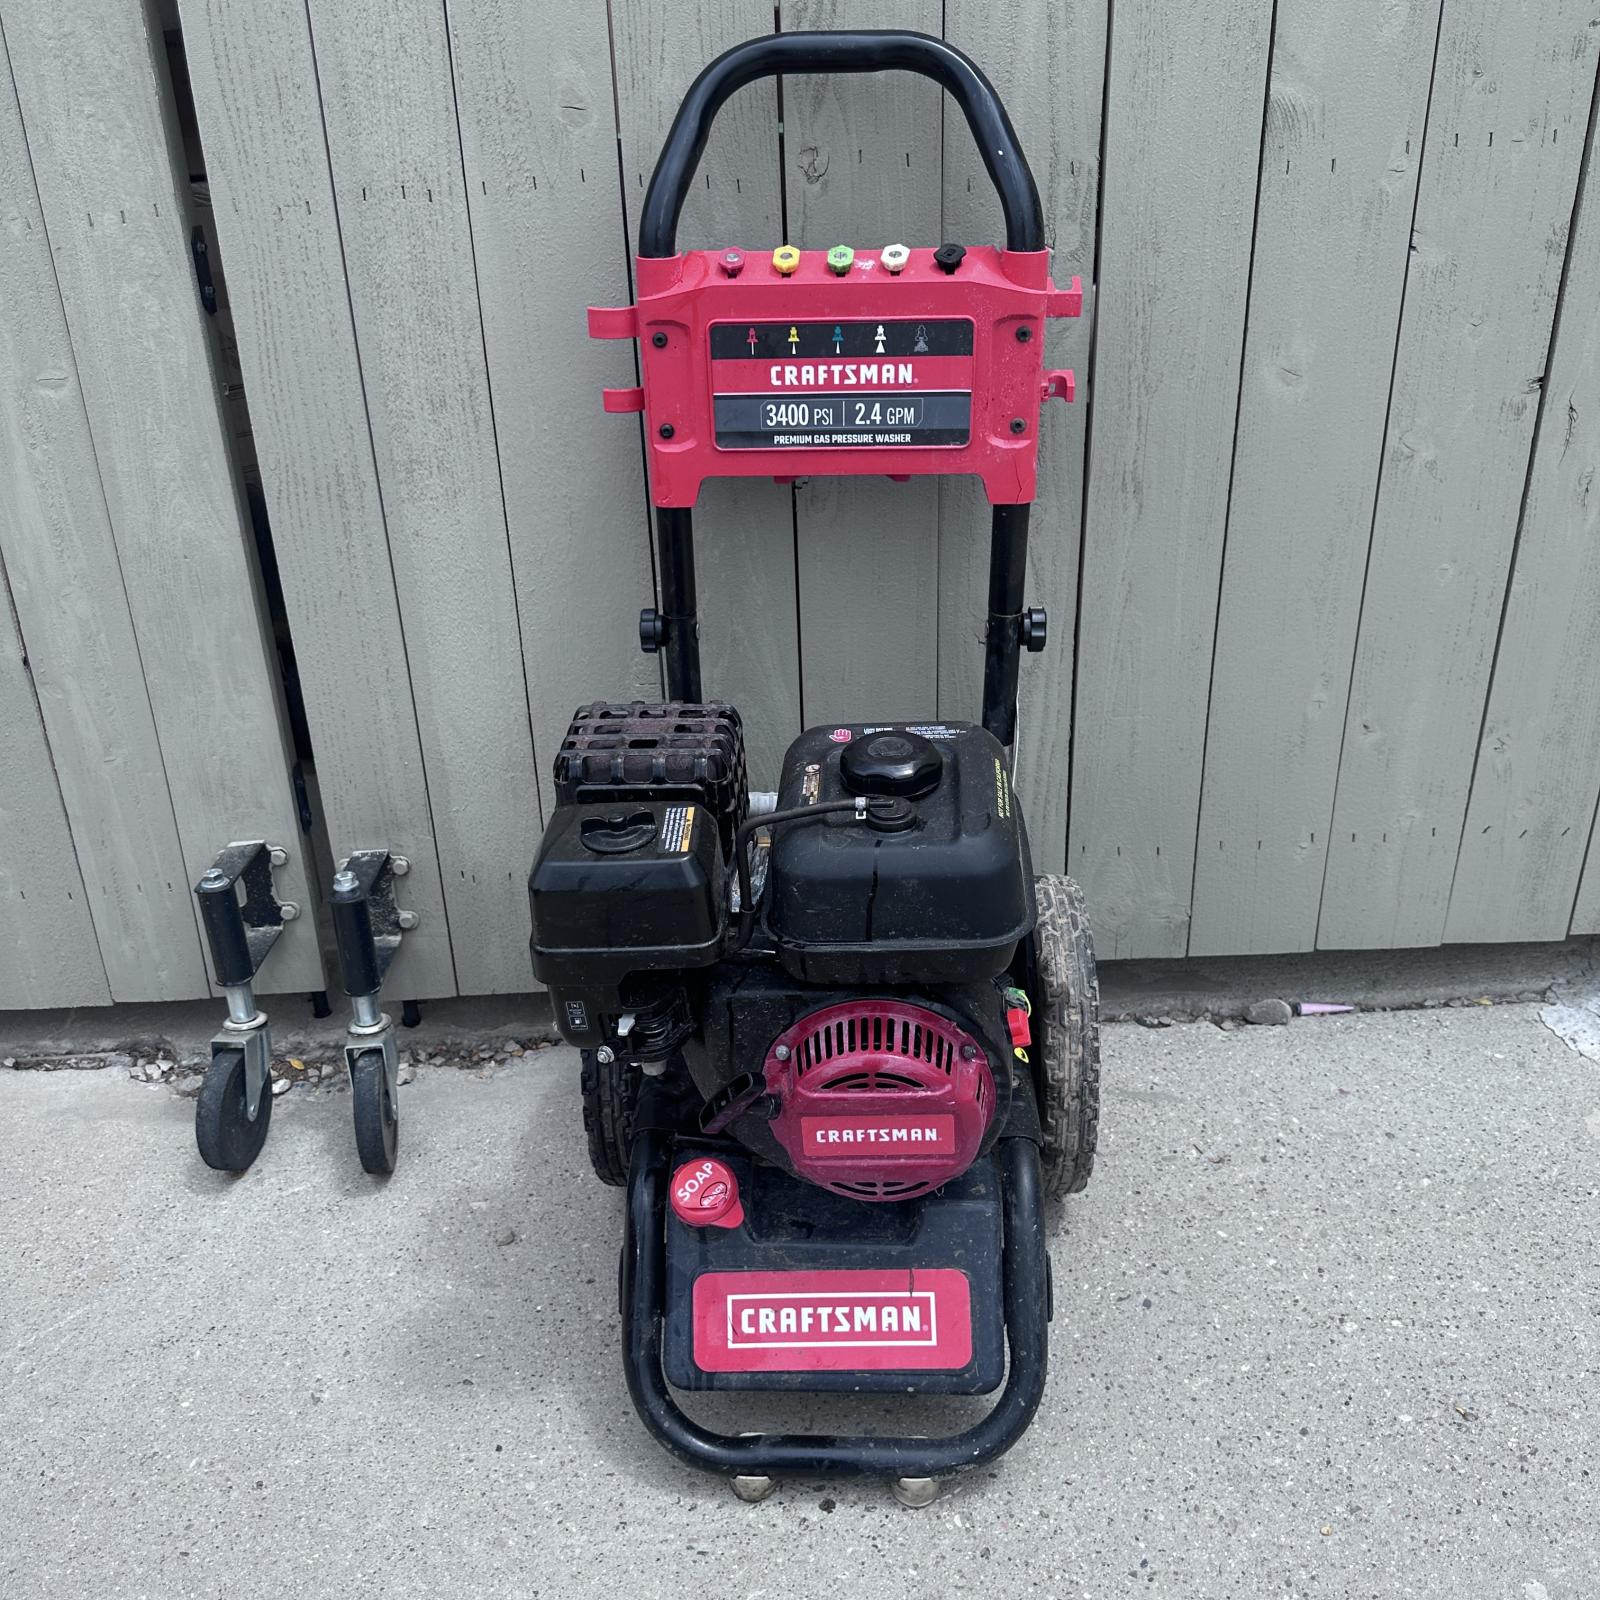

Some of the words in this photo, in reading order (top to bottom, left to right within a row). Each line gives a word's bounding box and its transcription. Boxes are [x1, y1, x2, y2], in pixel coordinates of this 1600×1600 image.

[770, 363, 913, 386] CRAFTSMAN
[766, 403, 809, 427] 3400
[813, 408, 833, 426] PSI
[854, 402, 883, 425] 2.4
[886, 407, 915, 425] GPM
[773, 434, 812, 445] PREMIUM
[813, 434, 830, 444] GAS
[831, 433, 874, 444] PRESSURE
[874, 433, 911, 443] WASHER
[816, 1128, 937, 1143] CRAFTSMAN
[677, 1162, 713, 1202] SOAP
[741, 1305, 921, 1334] CRAFTSMAN
